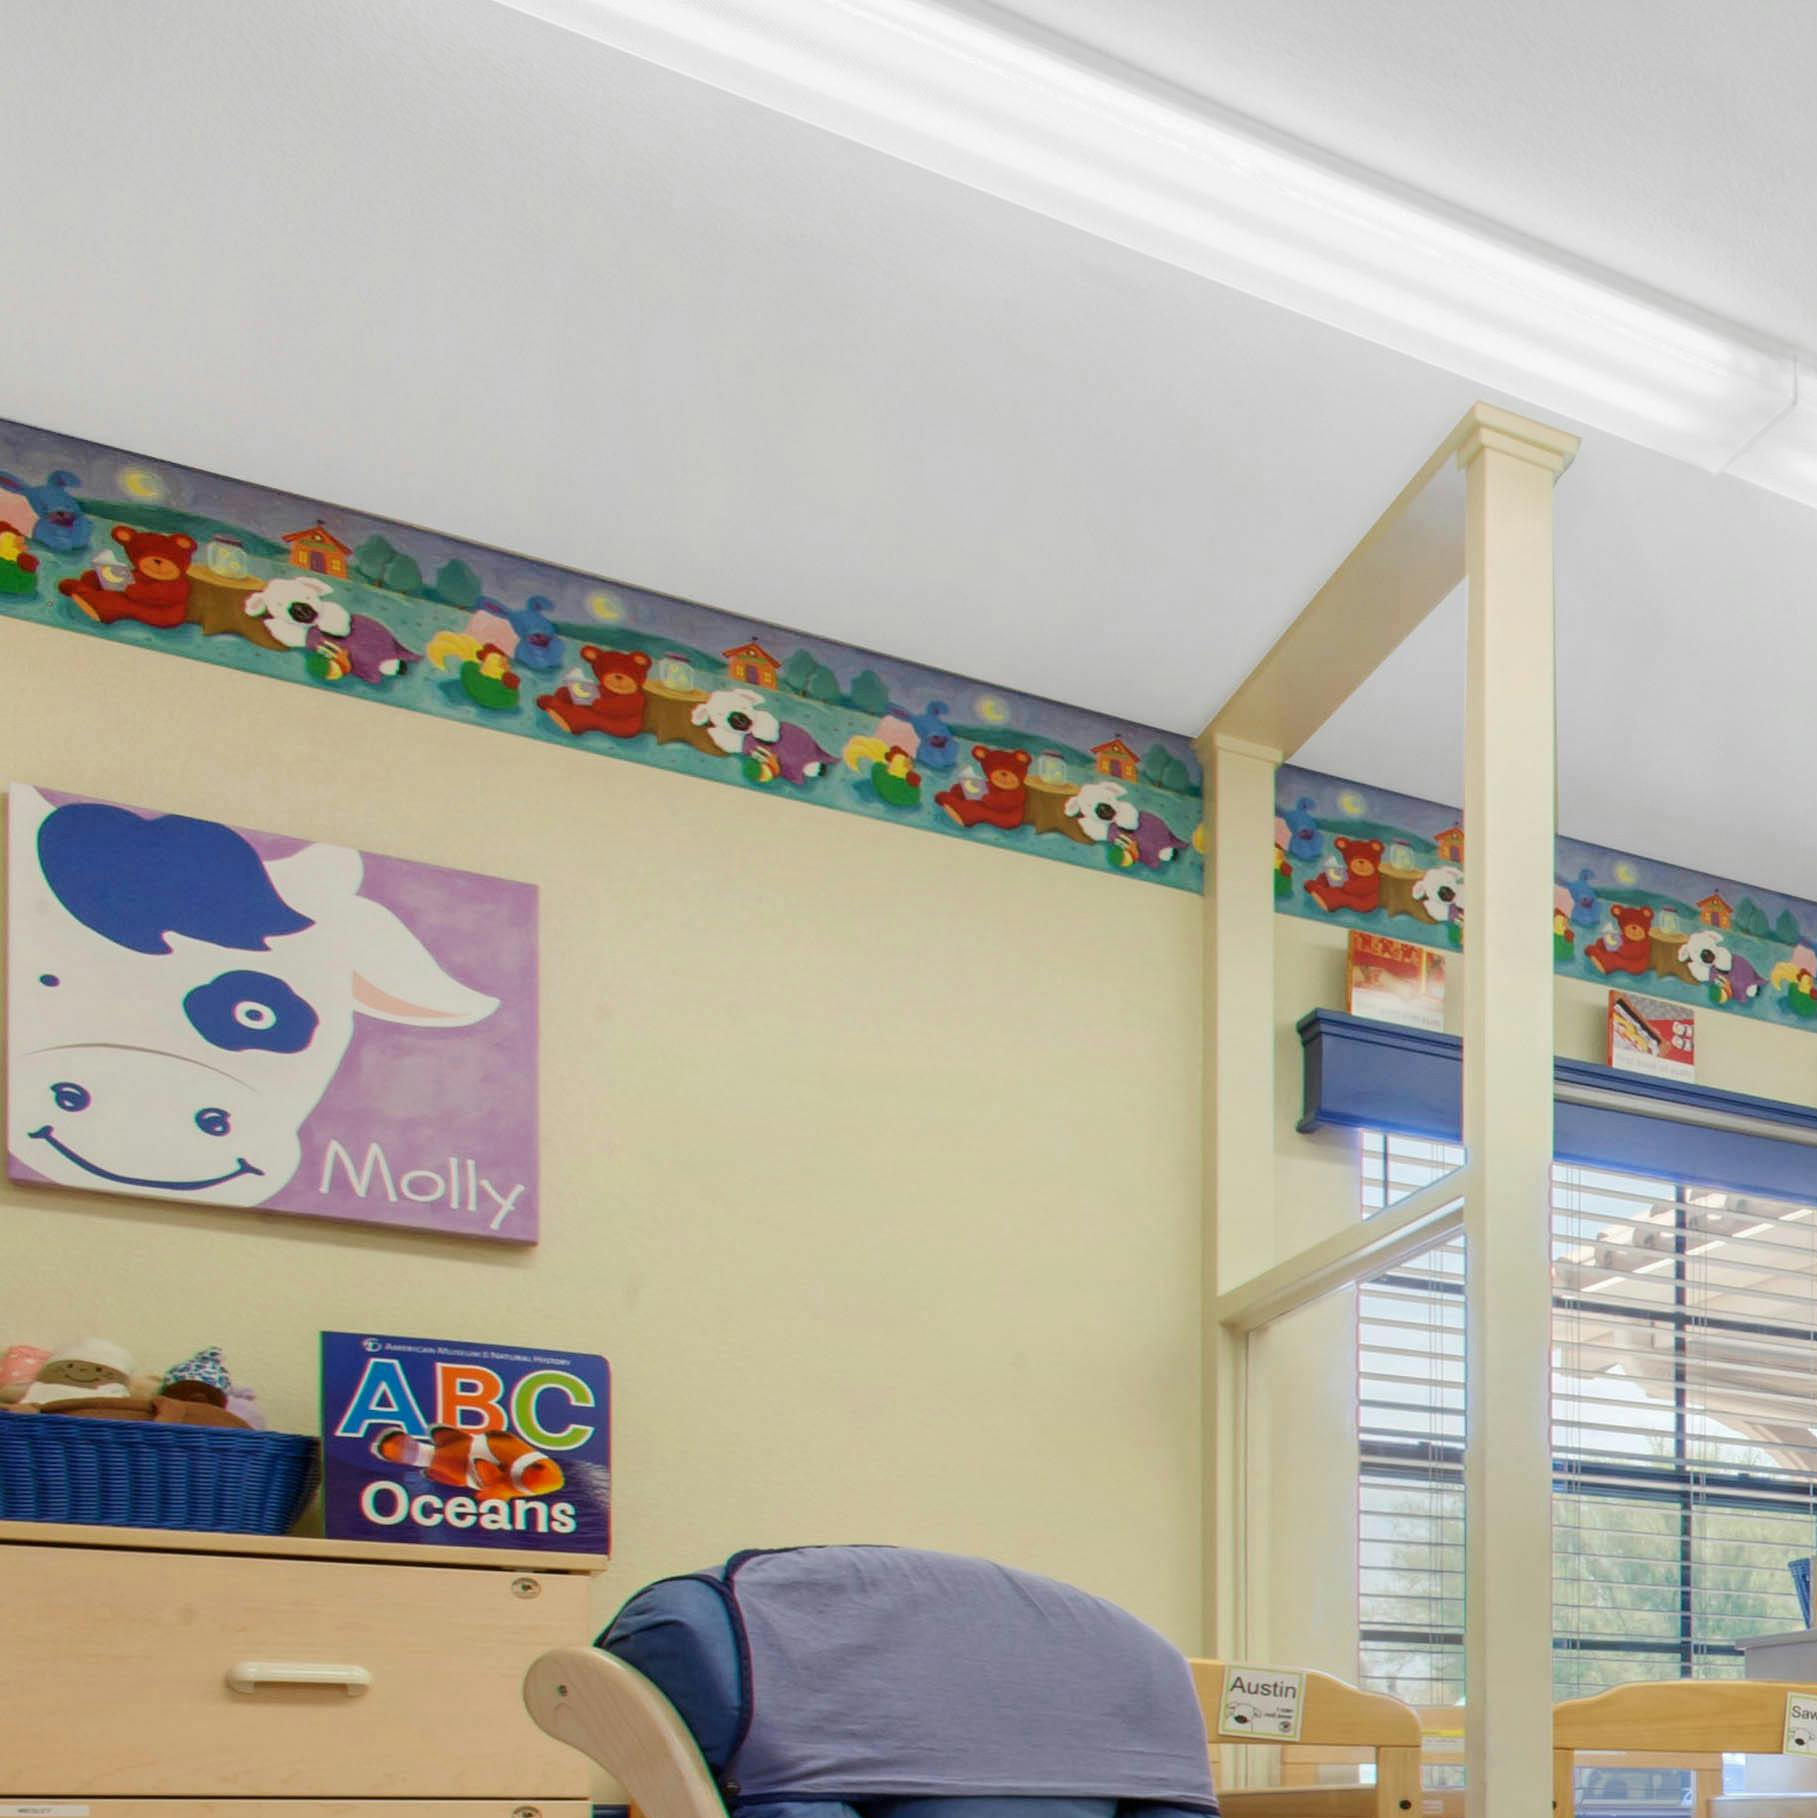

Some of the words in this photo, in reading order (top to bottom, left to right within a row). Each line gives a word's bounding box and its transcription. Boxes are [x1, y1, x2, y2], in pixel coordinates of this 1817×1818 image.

[319, 1139, 526, 1230] Molly
[334, 1357, 596, 1451] ABC
[359, 1480, 577, 1533] Oceans
[1230, 1676, 1297, 1699] Austin
